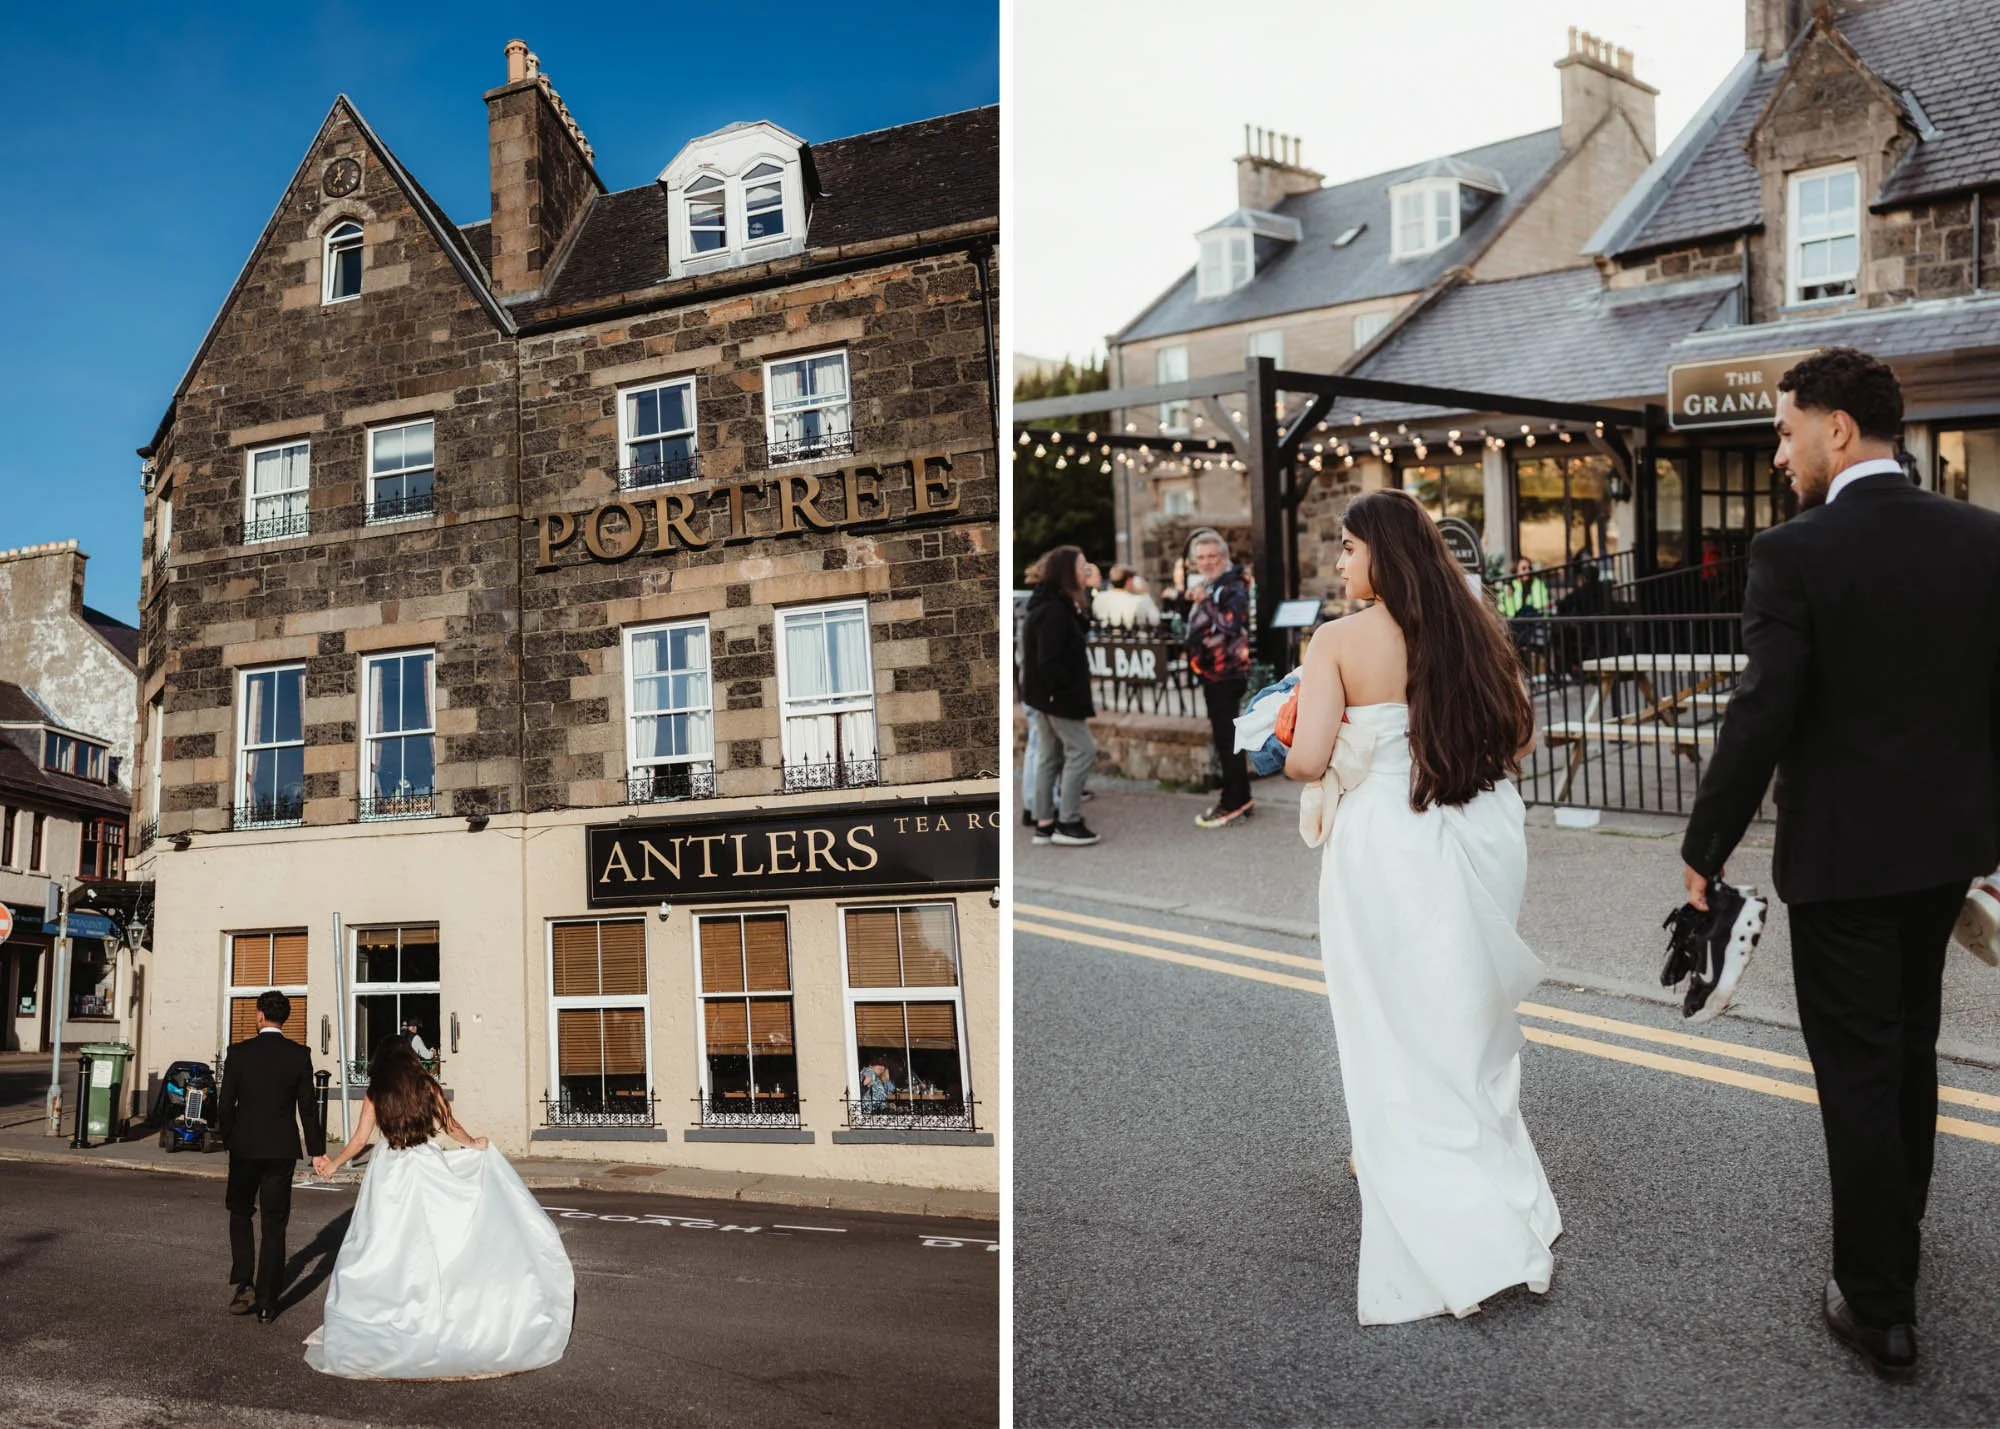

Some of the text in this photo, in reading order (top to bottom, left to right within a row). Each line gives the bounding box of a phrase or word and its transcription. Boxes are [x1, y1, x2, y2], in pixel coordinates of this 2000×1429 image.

[1725, 370, 1763, 387] THE
[535, 452, 961, 573] PORTREE
[1114, 647, 1157, 680] BAR
[600, 824, 879, 883] ANTLERS
[894, 814, 950, 834] TEA
[560, 1212, 762, 1233] COACH
